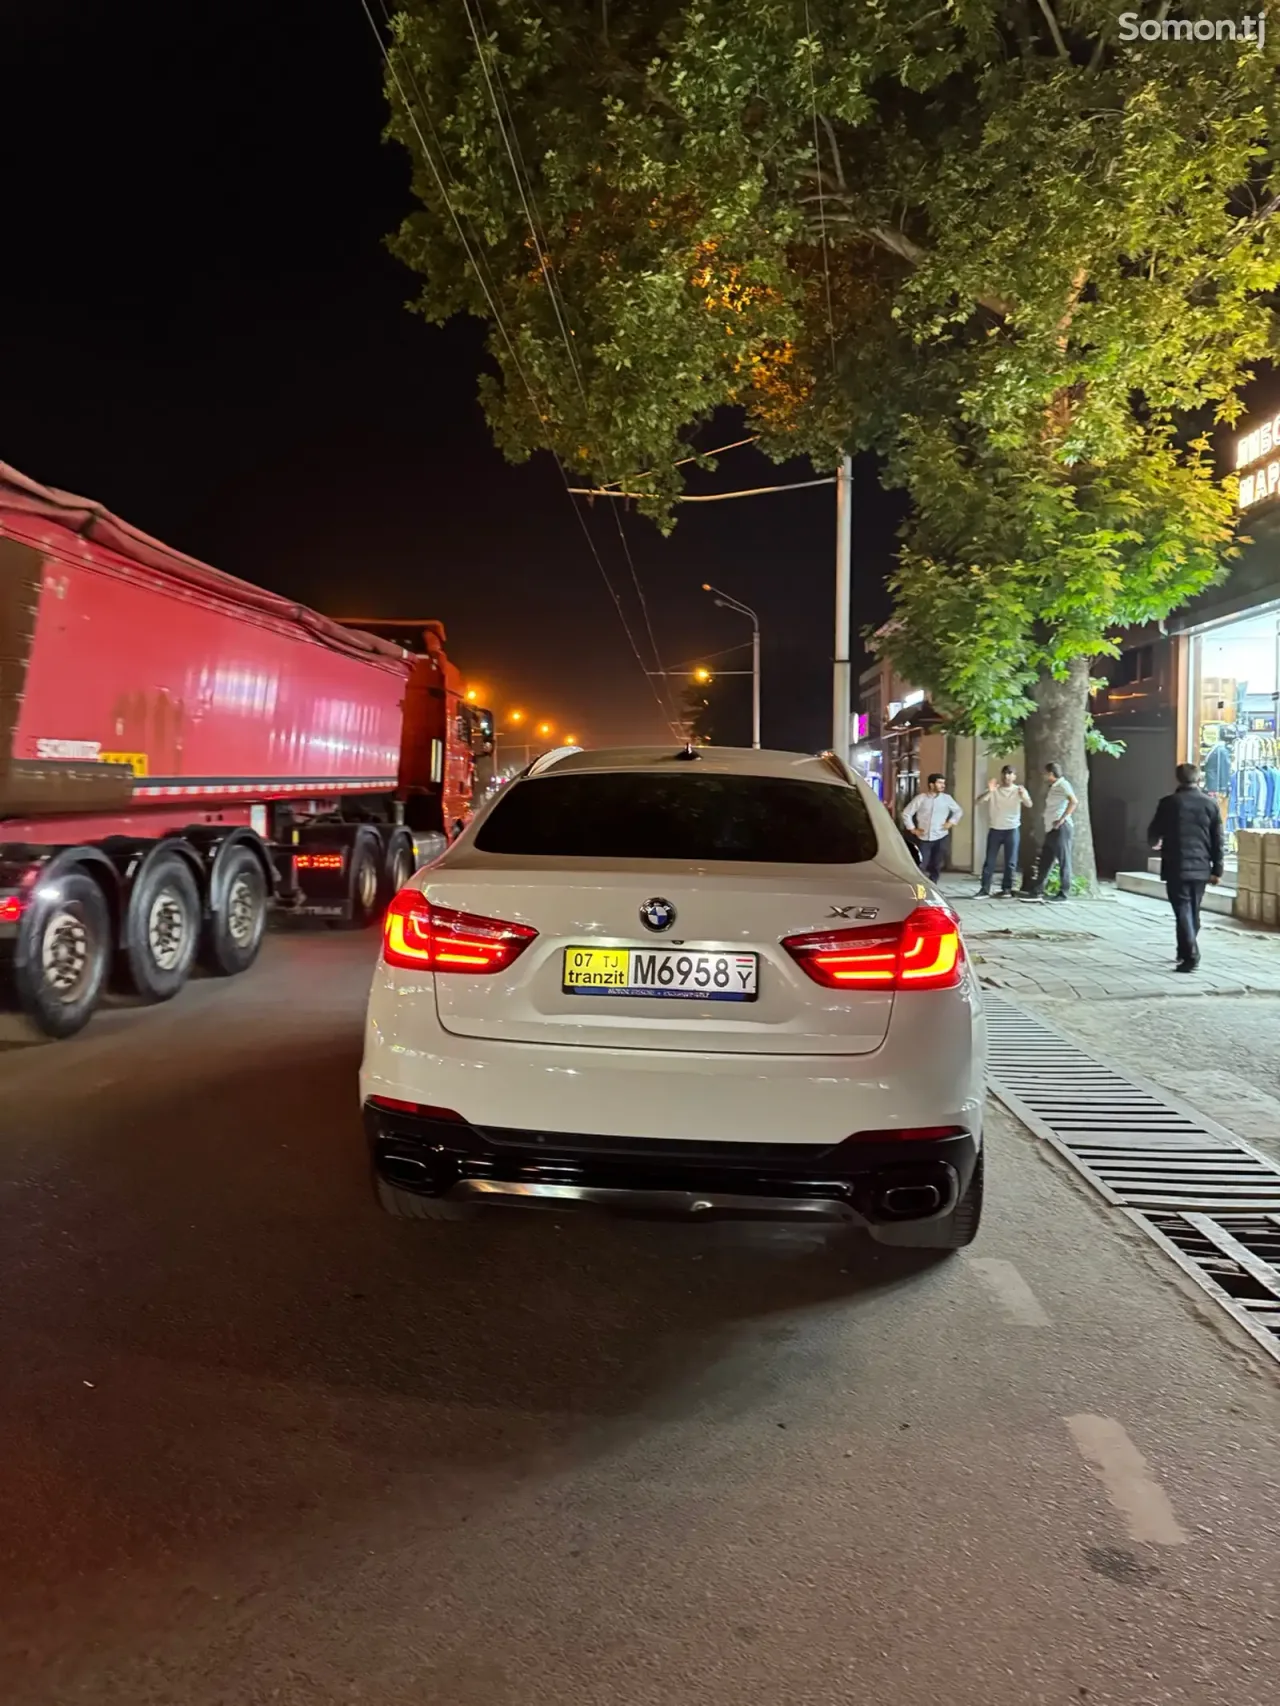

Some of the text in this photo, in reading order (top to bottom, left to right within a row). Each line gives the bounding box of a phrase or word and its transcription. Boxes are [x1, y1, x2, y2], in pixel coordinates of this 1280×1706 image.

[574, 953, 619, 969] 07 TJ
[568, 970, 625, 985] tranzit
[633, 954, 753, 989] M6958 Y
